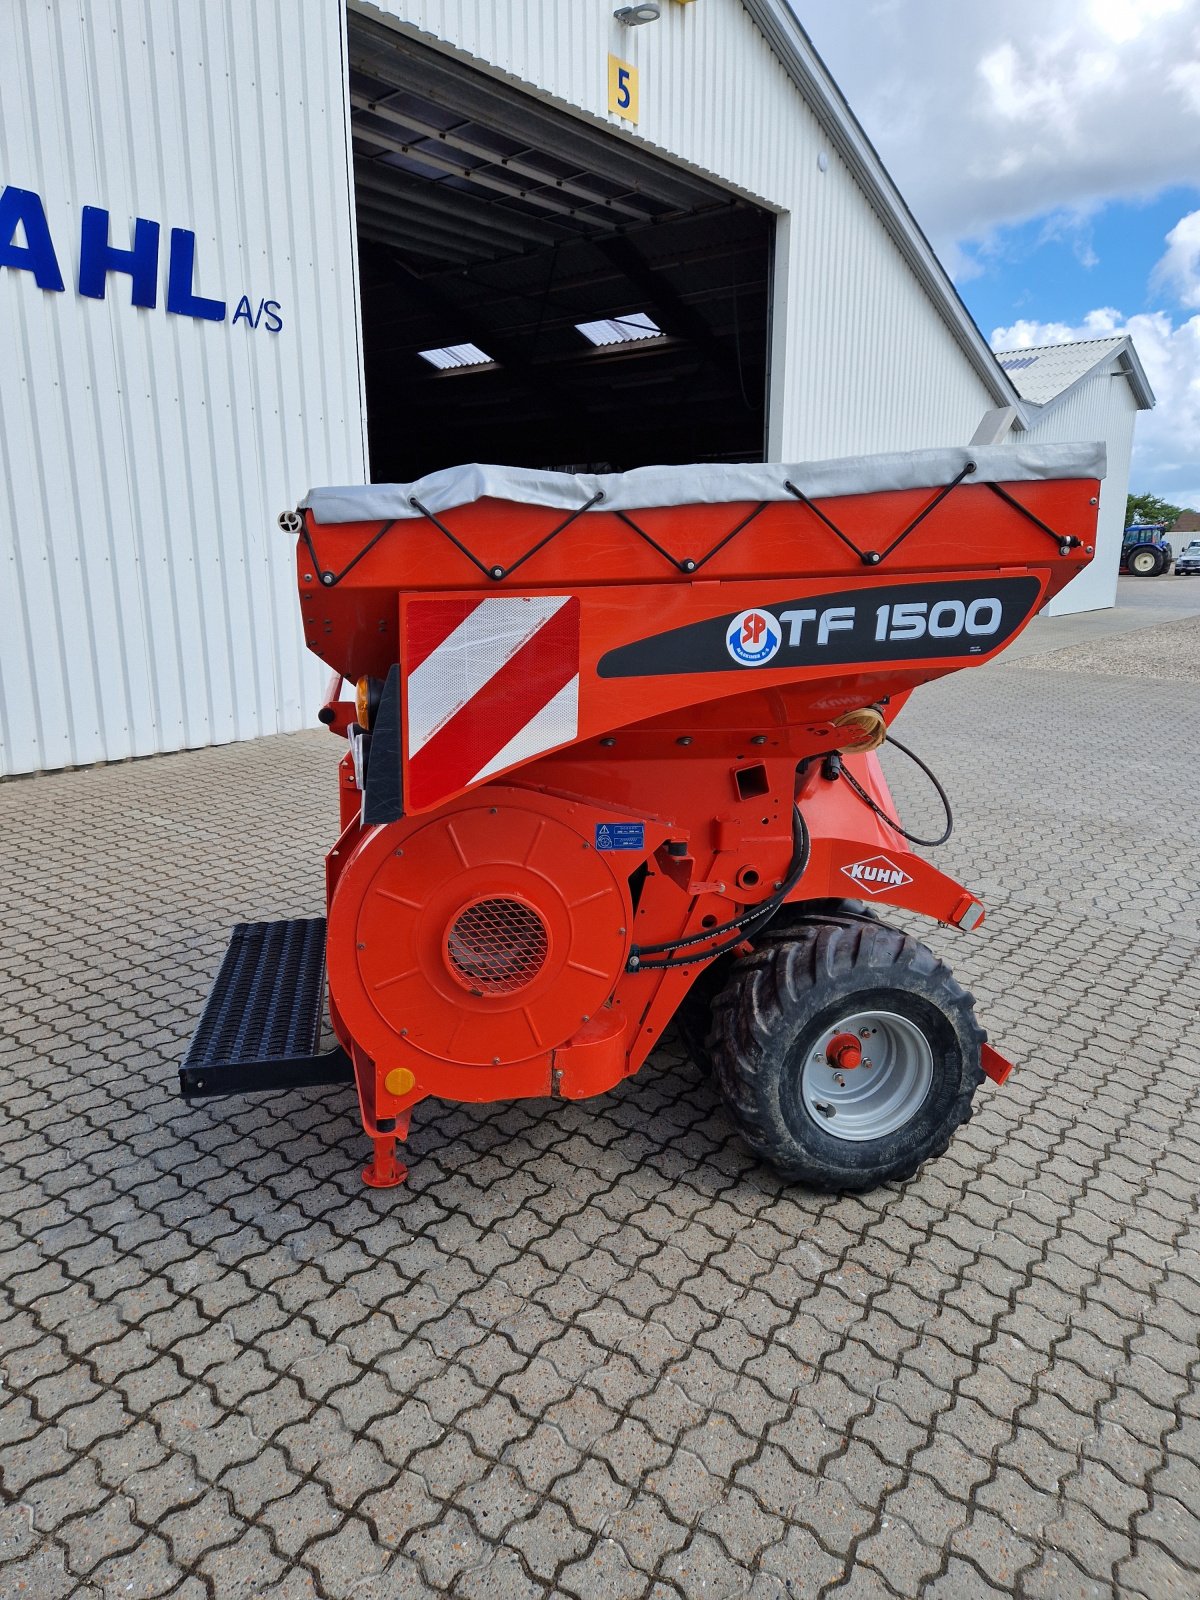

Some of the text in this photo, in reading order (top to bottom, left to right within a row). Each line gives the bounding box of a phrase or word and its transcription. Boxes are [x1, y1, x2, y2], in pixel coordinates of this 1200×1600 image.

[617, 67, 631, 109] 5
[0, 185, 284, 332] AHL A/S
[742, 613, 767, 644] SP
[778, 597, 1003, 648] TF 1500
[851, 864, 904, 885] KUHN
